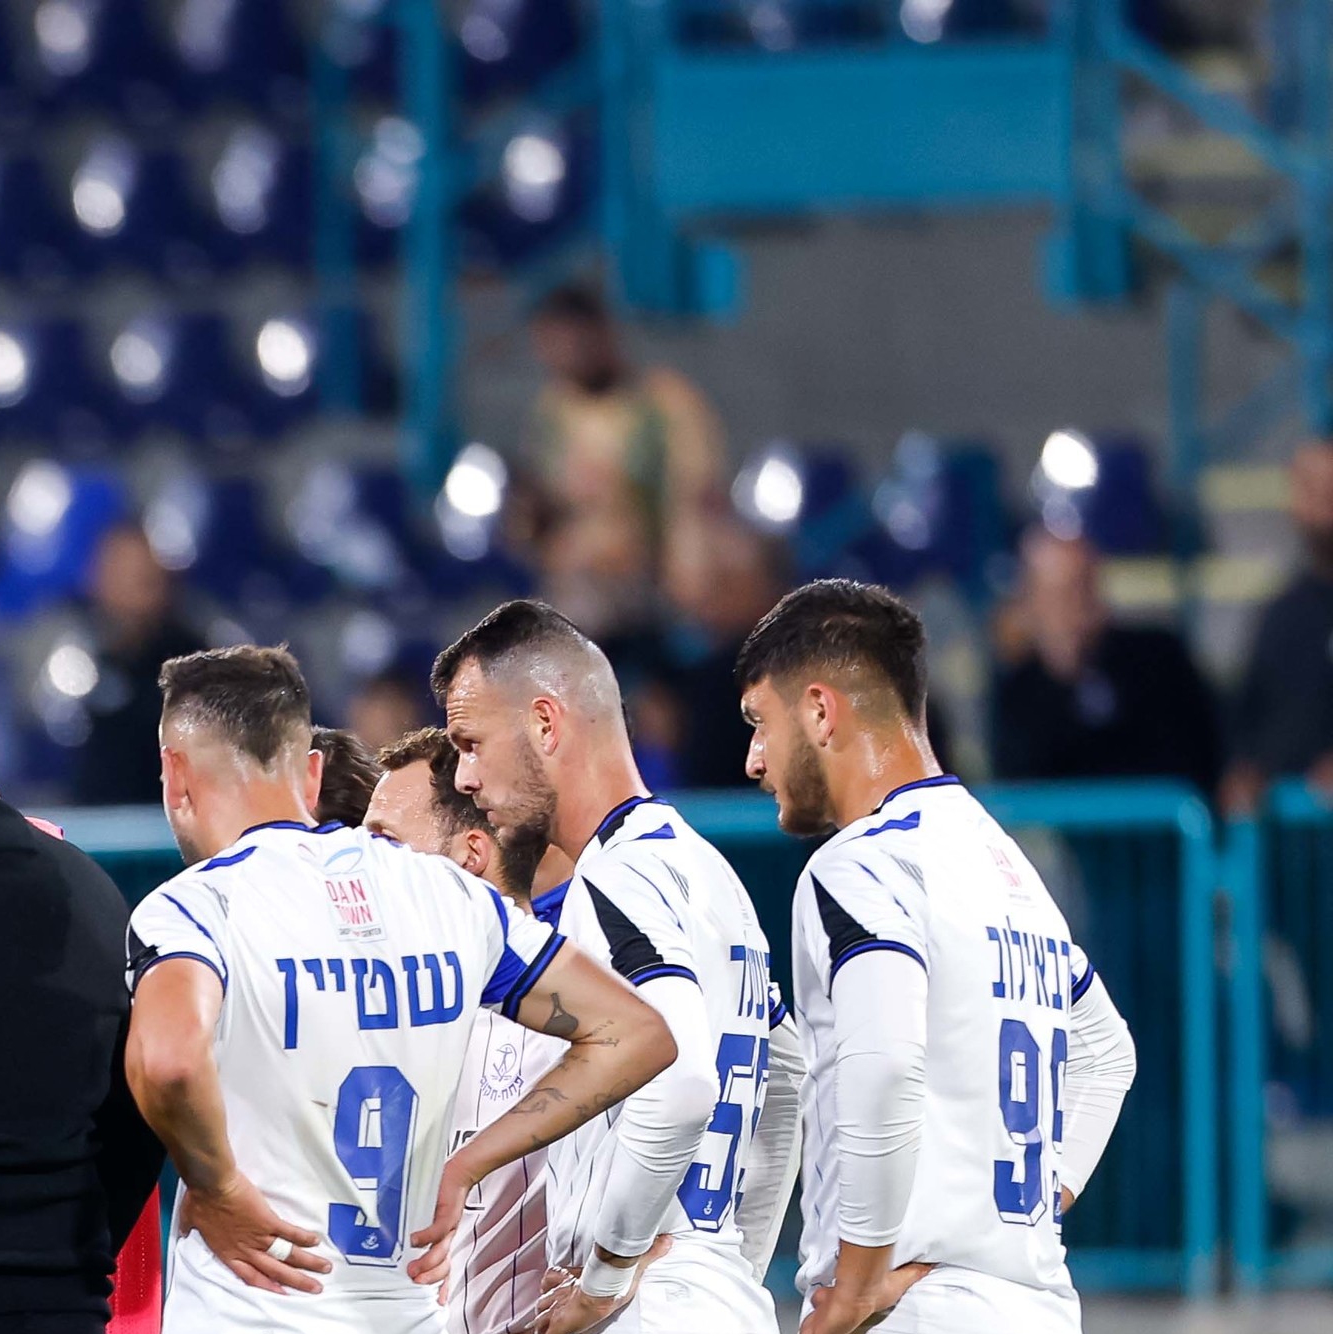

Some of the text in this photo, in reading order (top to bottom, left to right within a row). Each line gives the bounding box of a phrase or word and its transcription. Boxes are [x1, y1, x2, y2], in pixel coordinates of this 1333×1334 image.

[324, 879, 366, 903] DAN
[275, 950, 464, 1050] שטיין
[327, 1066, 420, 1267] 9
